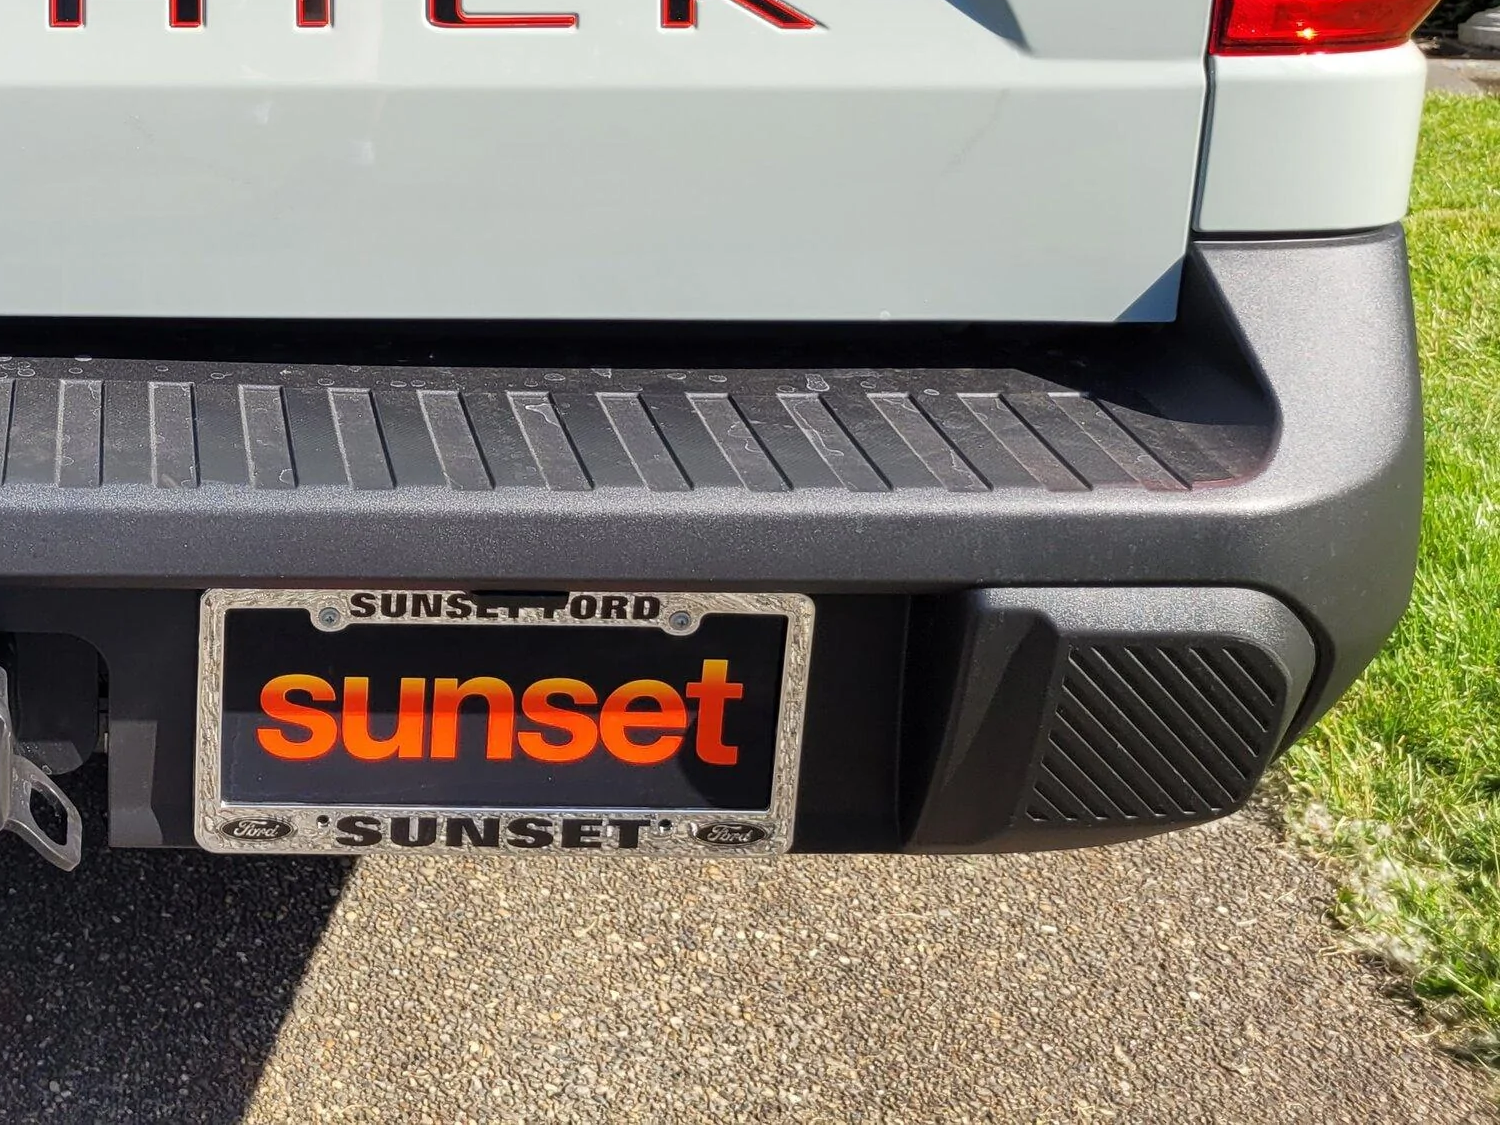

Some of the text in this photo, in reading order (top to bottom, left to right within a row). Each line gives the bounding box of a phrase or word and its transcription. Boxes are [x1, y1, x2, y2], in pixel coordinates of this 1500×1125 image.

[257, 659, 743, 766] sunset
[233, 820, 279, 838] Ford
[335, 815, 652, 849] SUNSET
[706, 824, 752, 843] Ford
